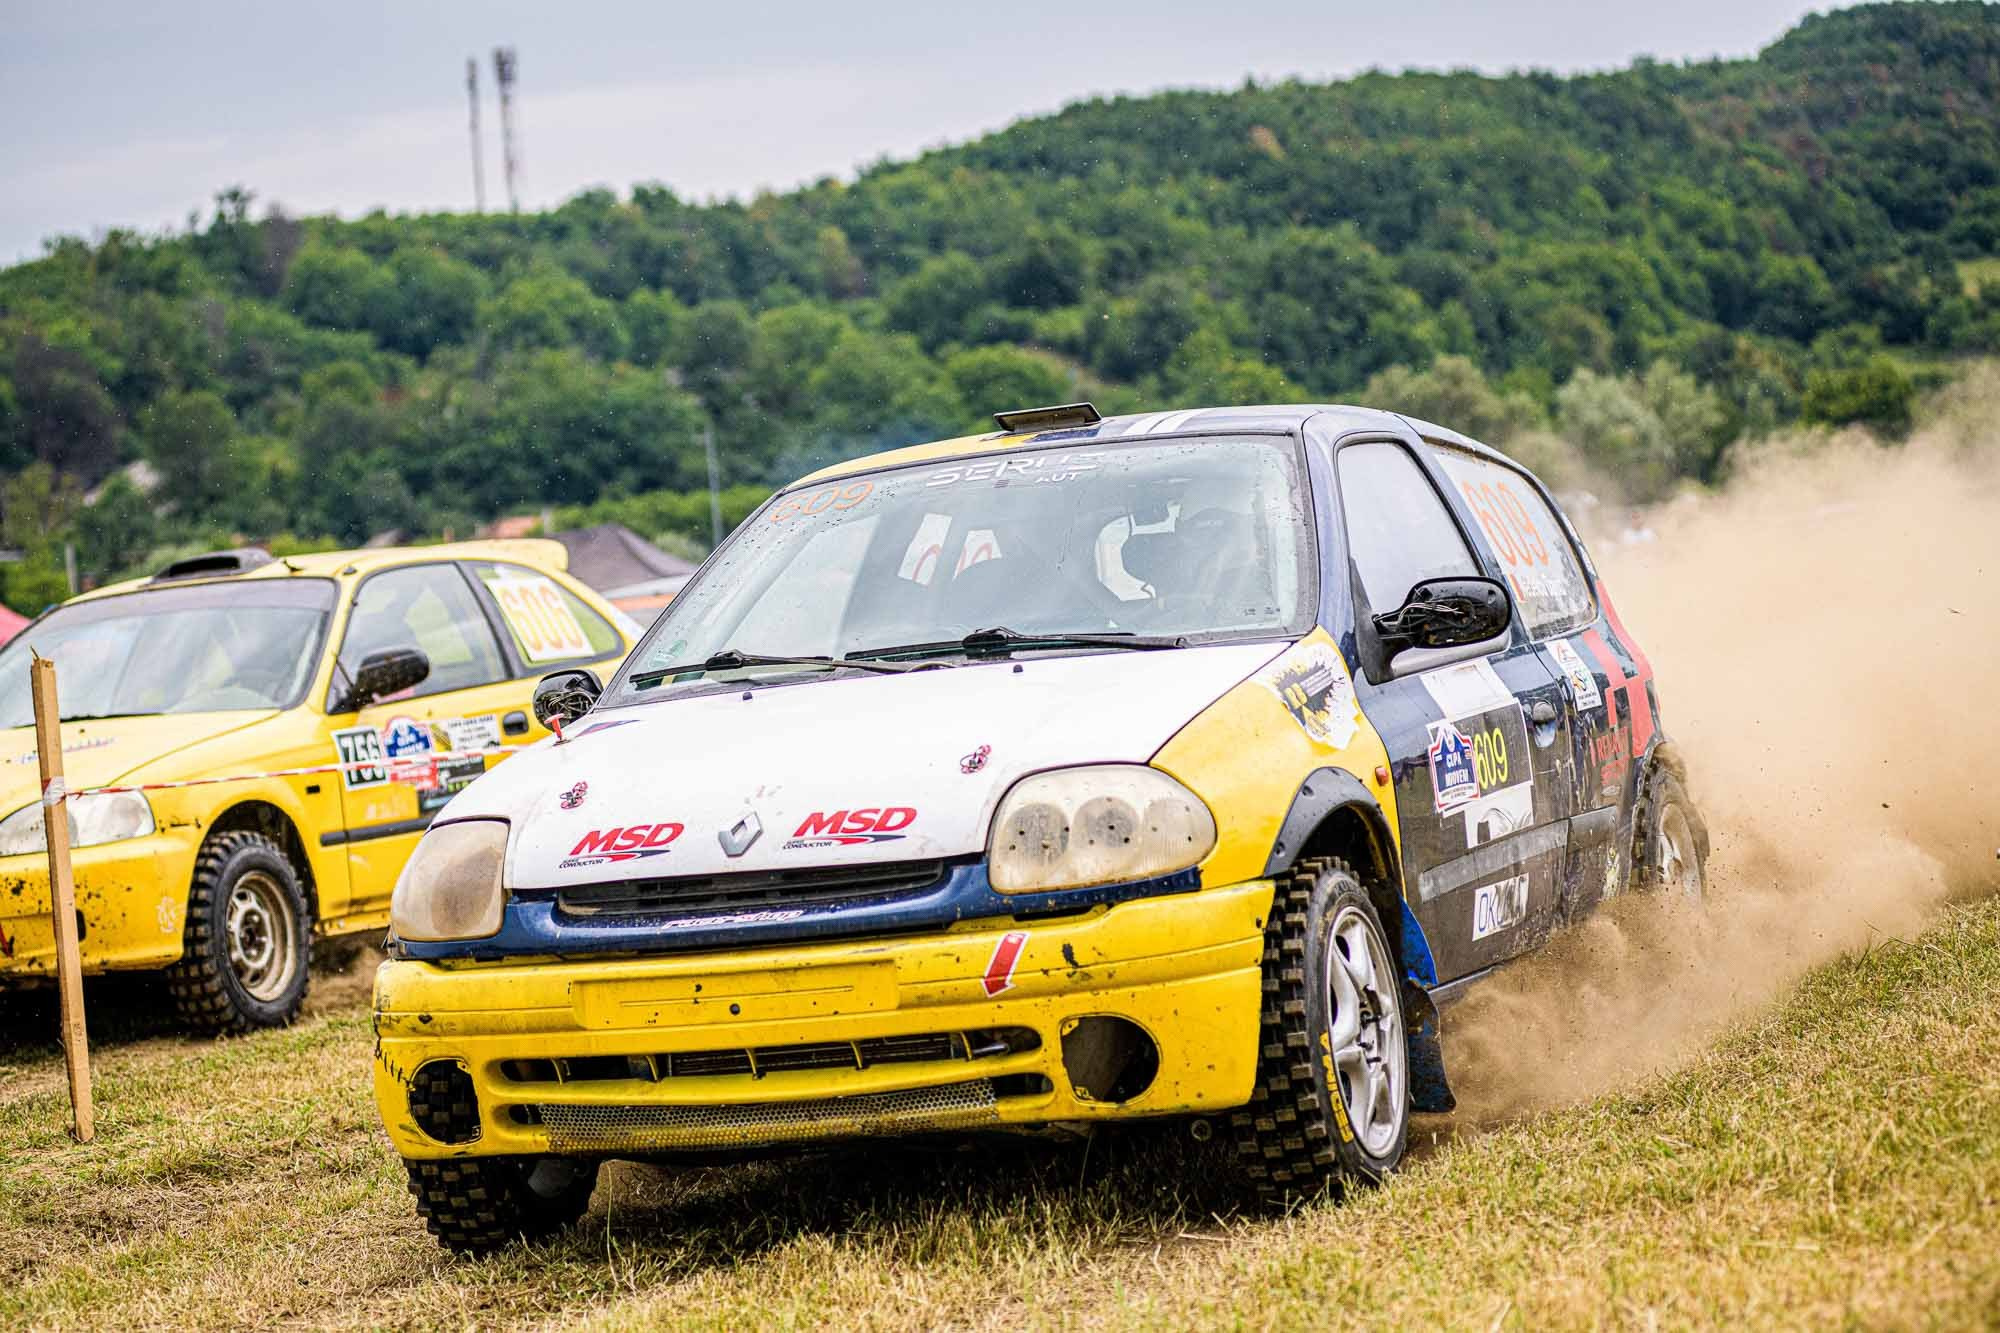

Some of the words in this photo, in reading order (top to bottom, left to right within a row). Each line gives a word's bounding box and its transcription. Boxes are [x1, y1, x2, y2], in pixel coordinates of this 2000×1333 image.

[770, 481, 874, 524] 609
[1462, 480, 1549, 567] 609
[339, 731, 386, 782] 756
[1473, 727, 1508, 790] 609
[569, 822, 685, 855] MSD
[793, 807, 918, 837] MSD
[559, 859, 604, 869] CONDUCTOR
[782, 841, 833, 851] CONDUCTOR
